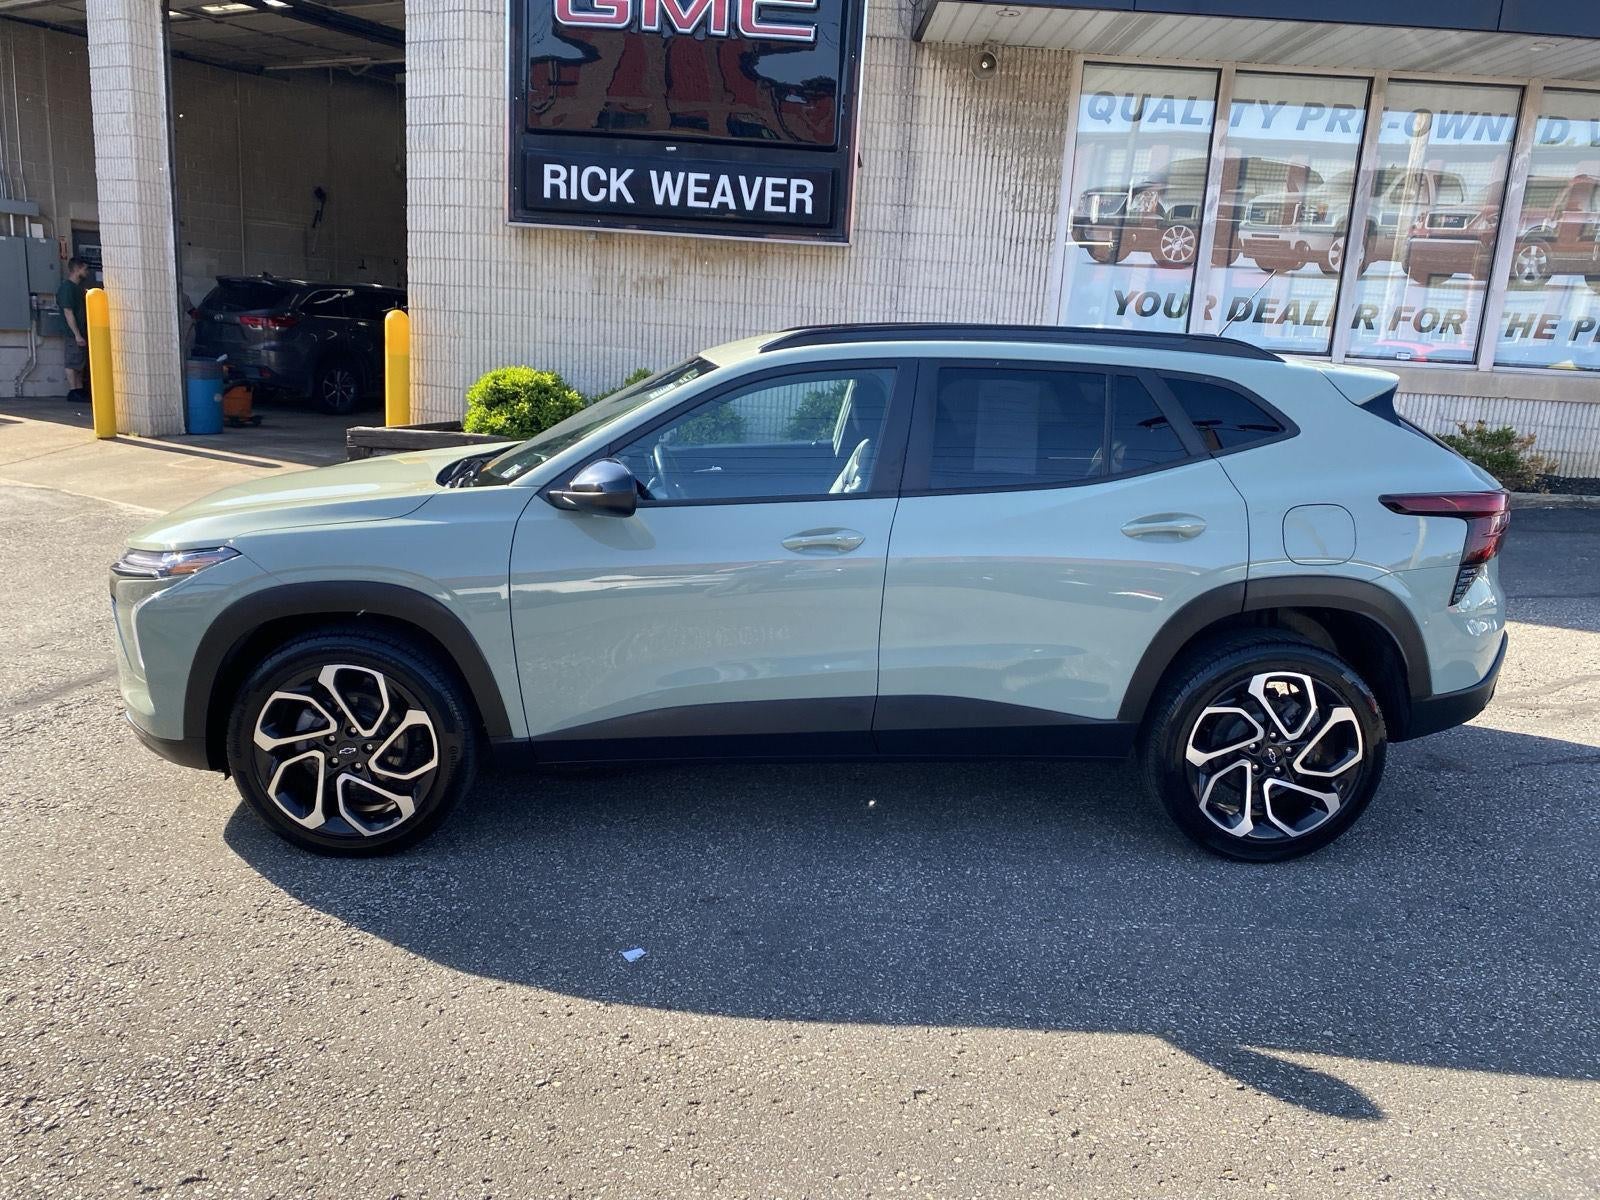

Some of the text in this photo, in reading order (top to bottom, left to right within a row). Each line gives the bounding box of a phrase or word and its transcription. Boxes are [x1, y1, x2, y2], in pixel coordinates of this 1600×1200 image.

[1087, 91, 1289, 129] QUALTY
[1295, 101, 1570, 145] PR-OWND
[543, 163, 815, 214] RICK WEAVER
[1388, 305, 1468, 335] FOR
